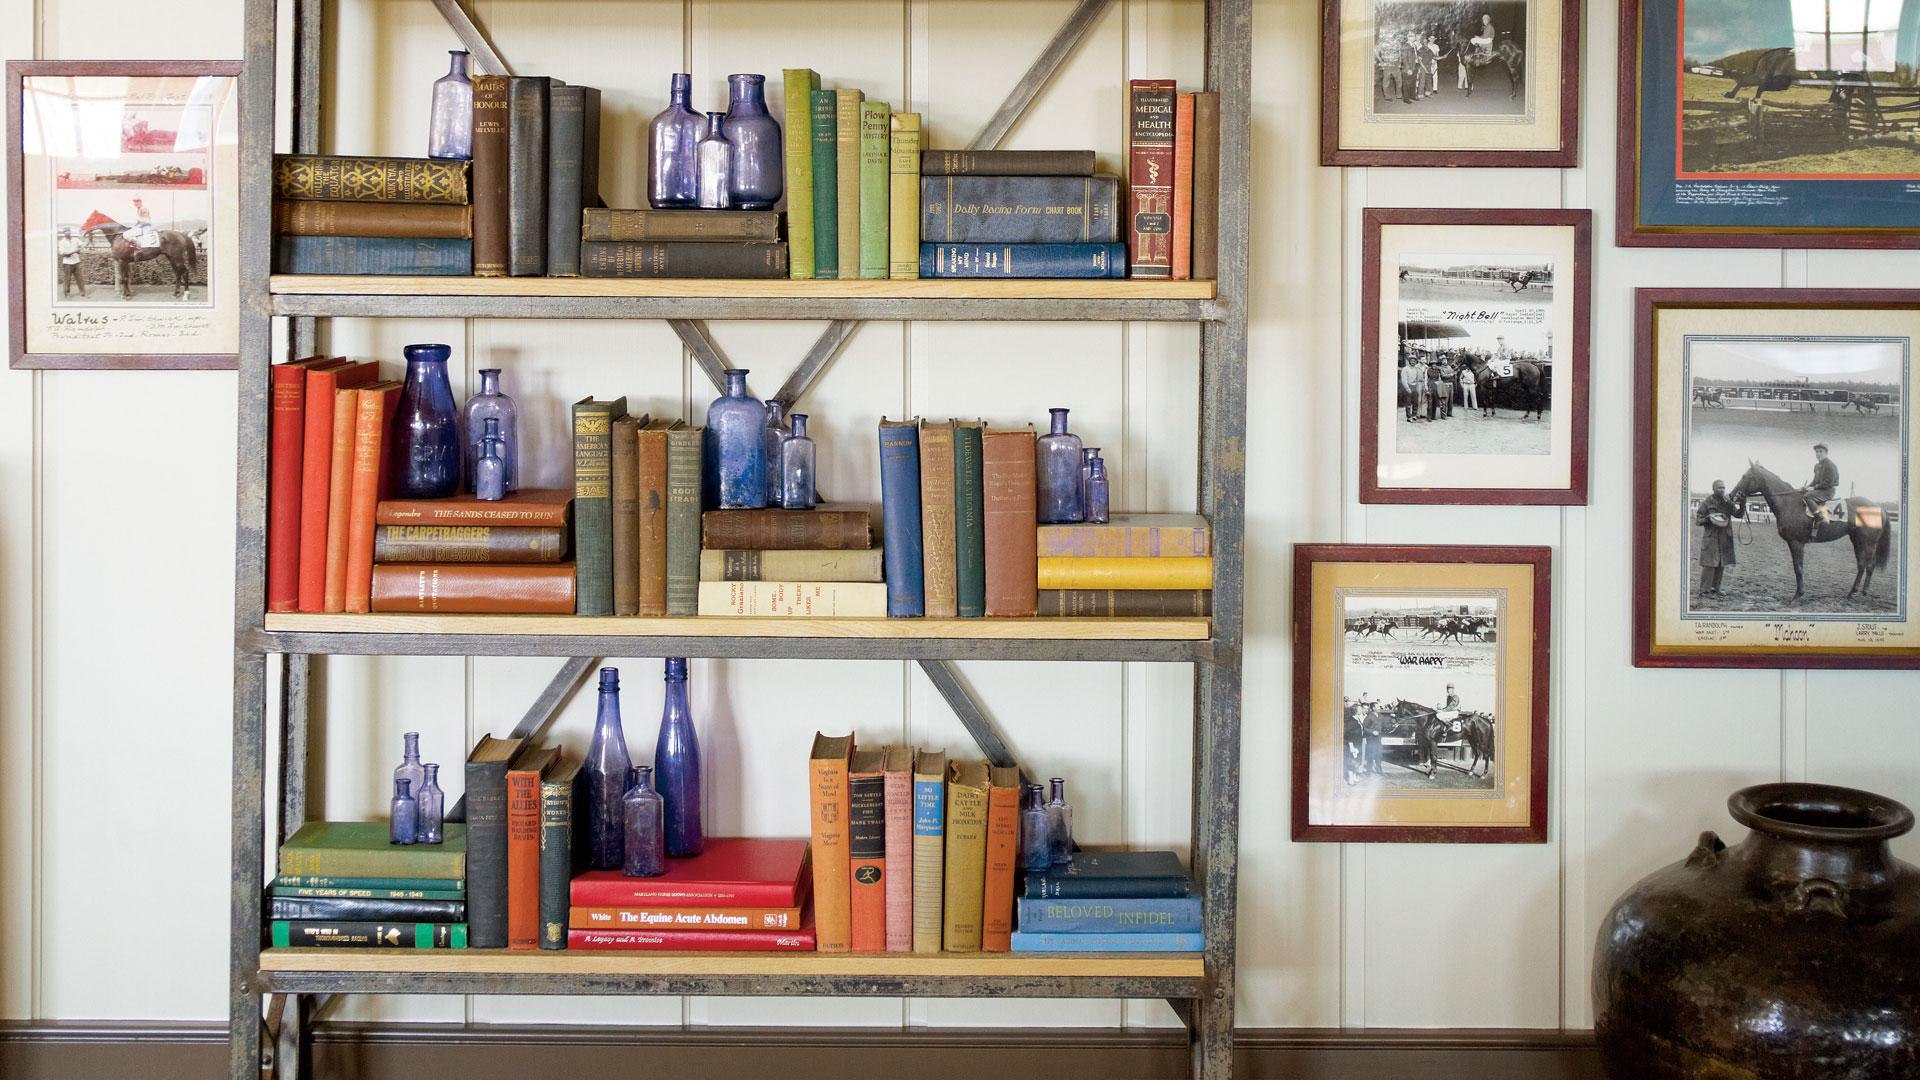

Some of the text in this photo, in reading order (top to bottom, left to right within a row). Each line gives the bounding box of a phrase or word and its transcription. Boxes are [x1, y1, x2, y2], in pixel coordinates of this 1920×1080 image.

[473, 101, 508, 109] HONOUR
[1135, 105, 1173, 113] MEDICAL
[864, 110, 886, 119] Plow
[862, 121, 889, 133] Penny
[1137, 120, 1172, 129] HEALTH
[329, 161, 339, 198] EQUATOR
[387, 181, 396, 199] MARK
[954, 203, 980, 216] Daily
[982, 203, 1013, 216] Racing
[1015, 204, 1041, 215] Form
[1044, 207, 1065, 215] CHART
[1066, 207, 1082, 215] BOOK
[599, 247, 607, 271] ENDING
[625, 245, 633, 274] AMERICAN
[957, 255, 963, 265] MY
[51, 312, 109, 325] Walrus
[1502, 366, 1512, 375] 5
[964, 436, 974, 485] TIDEWATER
[965, 488, 974, 528] VIRGINIA
[1833, 502, 1845, 519] 4
[434, 510, 452, 518] THE
[452, 510, 483, 518] SANDS
[484, 510, 519, 519] CEASED
[519, 511, 533, 519] TO
[533, 511, 554, 519] RUN
[386, 526, 490, 541] THE CARPETBAGGERS
[385, 544, 490, 562] HAROLD ROBBINS
[815, 586, 821, 597] ME
[737, 582, 745, 615] Graziano
[787, 606, 793, 615] UP
[1453, 720, 1461, 731] 8
[817, 768, 839, 777] Virginia
[512, 777, 535, 788] WITH
[516, 789, 532, 799] THE
[957, 791, 980, 799] DAIRY
[511, 799, 537, 811] ALLIES
[954, 799, 982, 807] CATTLE
[918, 816, 932, 824] John
[512, 833, 534, 841] DAVIS
[821, 831, 840, 840] Virginia
[1047, 904, 1114, 919] BELOVED
[591, 911, 748, 925] White The Equine Acute Abdomen
[1118, 911, 1175, 925] INFIDEL
